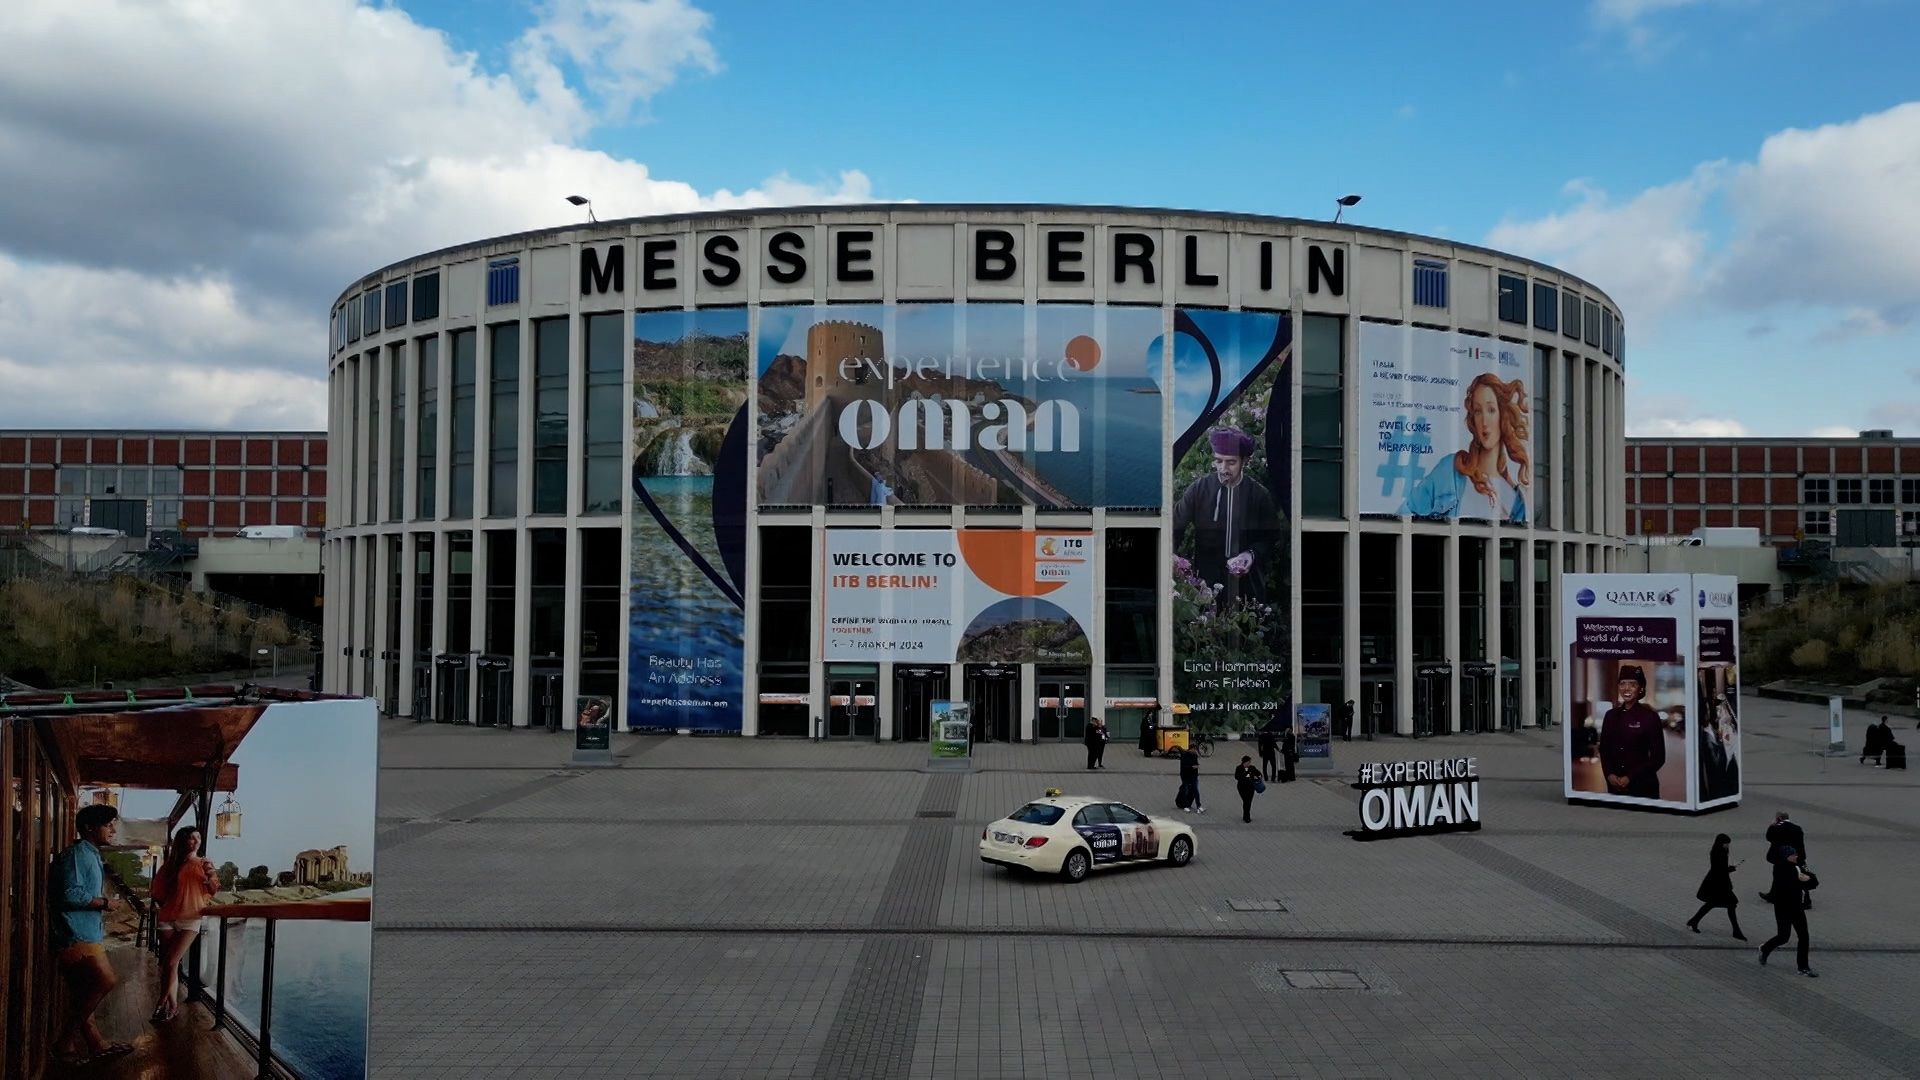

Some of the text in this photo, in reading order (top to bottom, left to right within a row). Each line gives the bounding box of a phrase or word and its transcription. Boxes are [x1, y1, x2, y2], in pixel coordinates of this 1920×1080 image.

[581, 230, 1344, 296] MESSE BERLIN
[838, 354, 1080, 390] experience
[838, 399, 1080, 451] oman
[1379, 432, 1392, 440] TO
[1064, 539, 1083, 548] ITB
[832, 553, 957, 567] WELCOME TO
[833, 575, 938, 588] ITB BERLIN!
[1606, 591, 1656, 603] QATAR
[857, 641, 896, 650] MARCH
[899, 641, 924, 650] 2024
[649, 655, 723, 670] Beauty Has
[1214, 660, 1282, 674] Hommage
[648, 671, 722, 685] An Address
[1222, 677, 1271, 689] Erleben
[1360, 757, 1478, 784] #EXPERIENCE
[1362, 782, 1479, 831] OMAN
